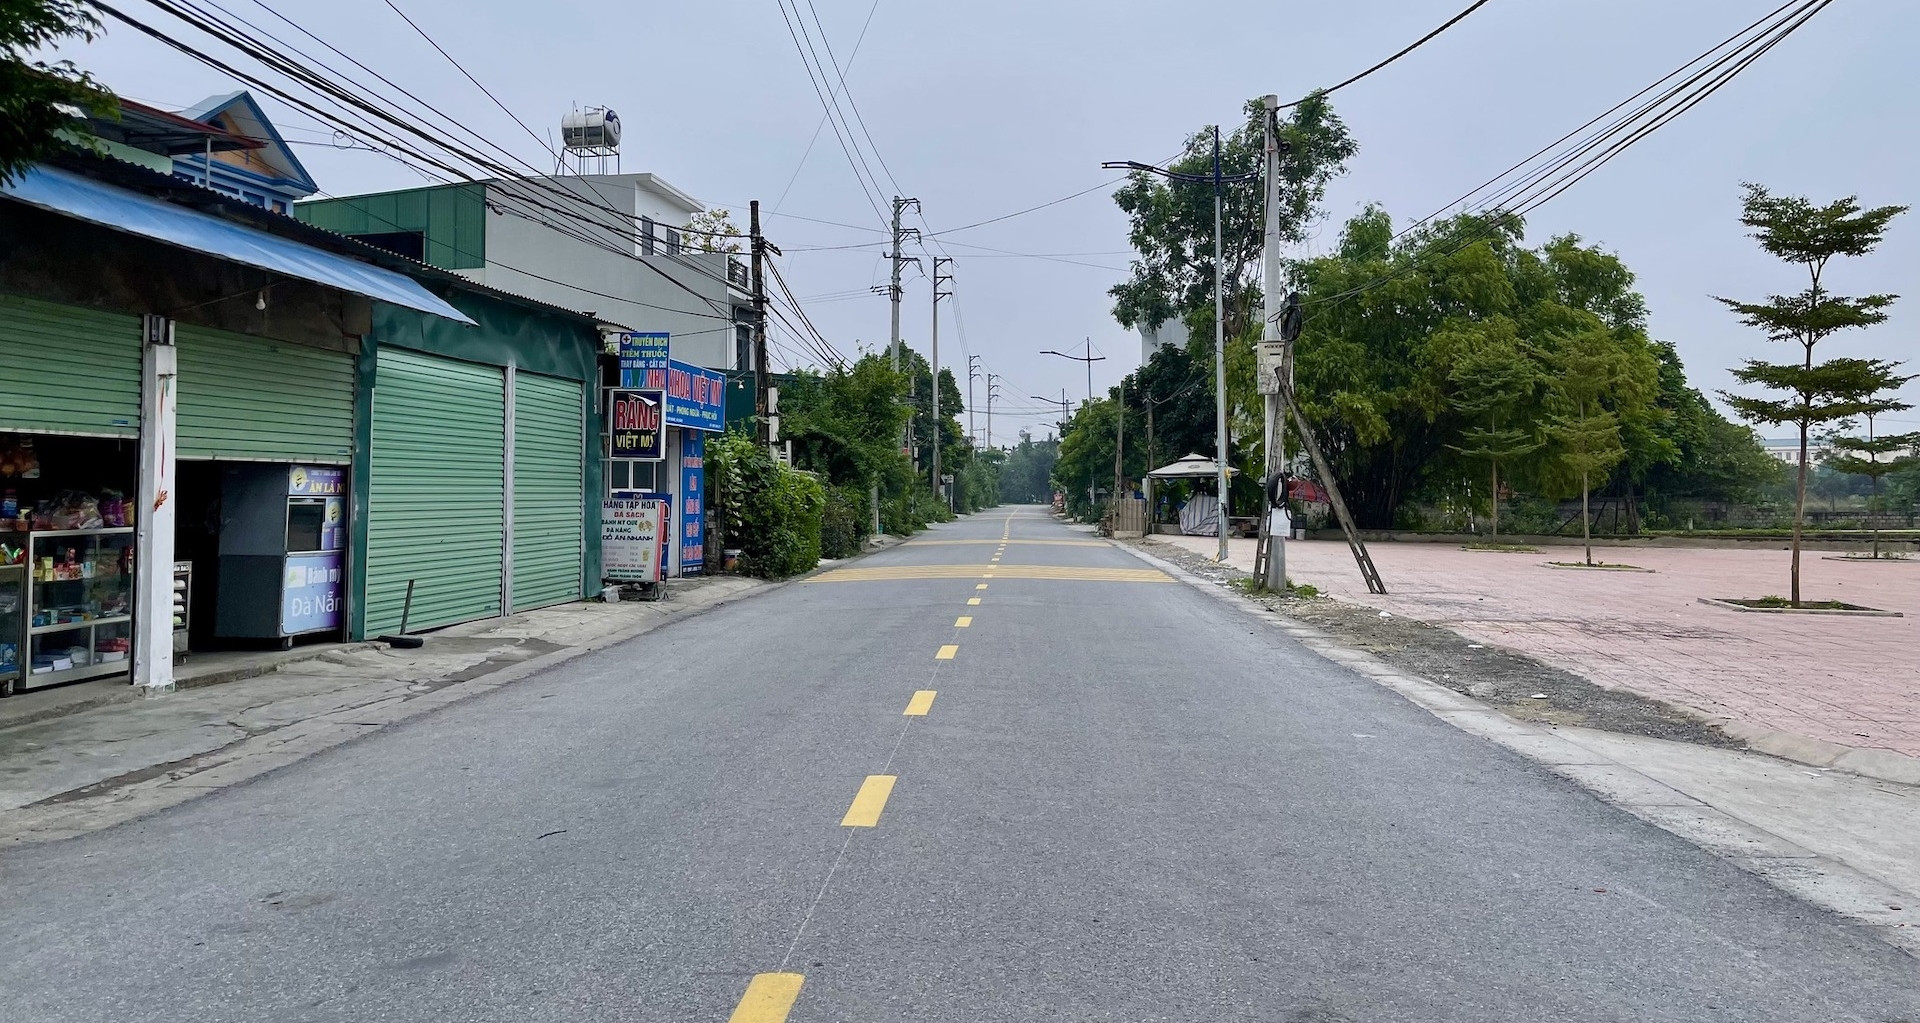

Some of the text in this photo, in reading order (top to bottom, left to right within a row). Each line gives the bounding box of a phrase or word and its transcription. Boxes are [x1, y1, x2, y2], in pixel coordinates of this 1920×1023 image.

[668, 368, 691, 401] KHOA
[616, 395, 660, 431] RĂNG
[616, 431, 638, 449] VIỆT
[292, 596, 311, 617] Đà
